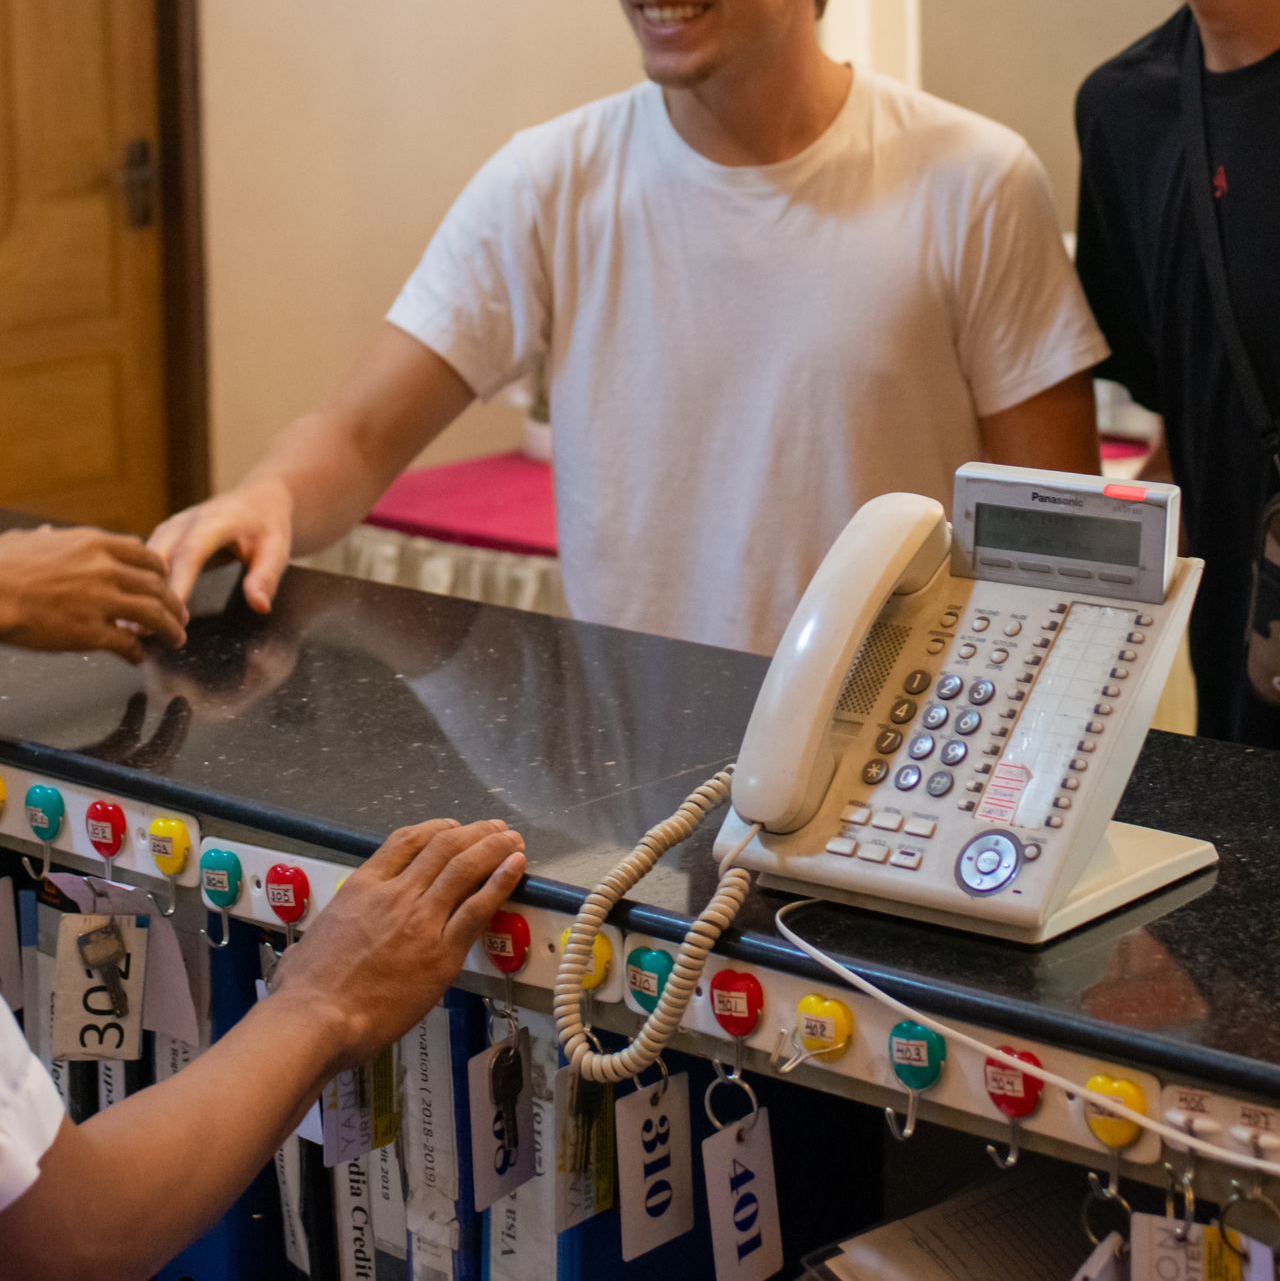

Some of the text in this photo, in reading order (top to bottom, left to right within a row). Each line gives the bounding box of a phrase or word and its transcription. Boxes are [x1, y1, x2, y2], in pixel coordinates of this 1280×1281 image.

[1031, 491, 1084, 508] Panasonic
[912, 674, 985, 699] 1 2 3
[894, 703, 971, 729] 4 5 6
[881, 732, 958, 758] 7 8 9
[899, 769, 913, 784] 0
[487, 937, 508, 952] 308
[640, 1113, 673, 1218] 310
[380, 1165, 391, 1201] 2019
[728, 1158, 762, 1265] 401
[350, 1206, 371, 1279] Credit
[500, 1209, 517, 1257] Visa
